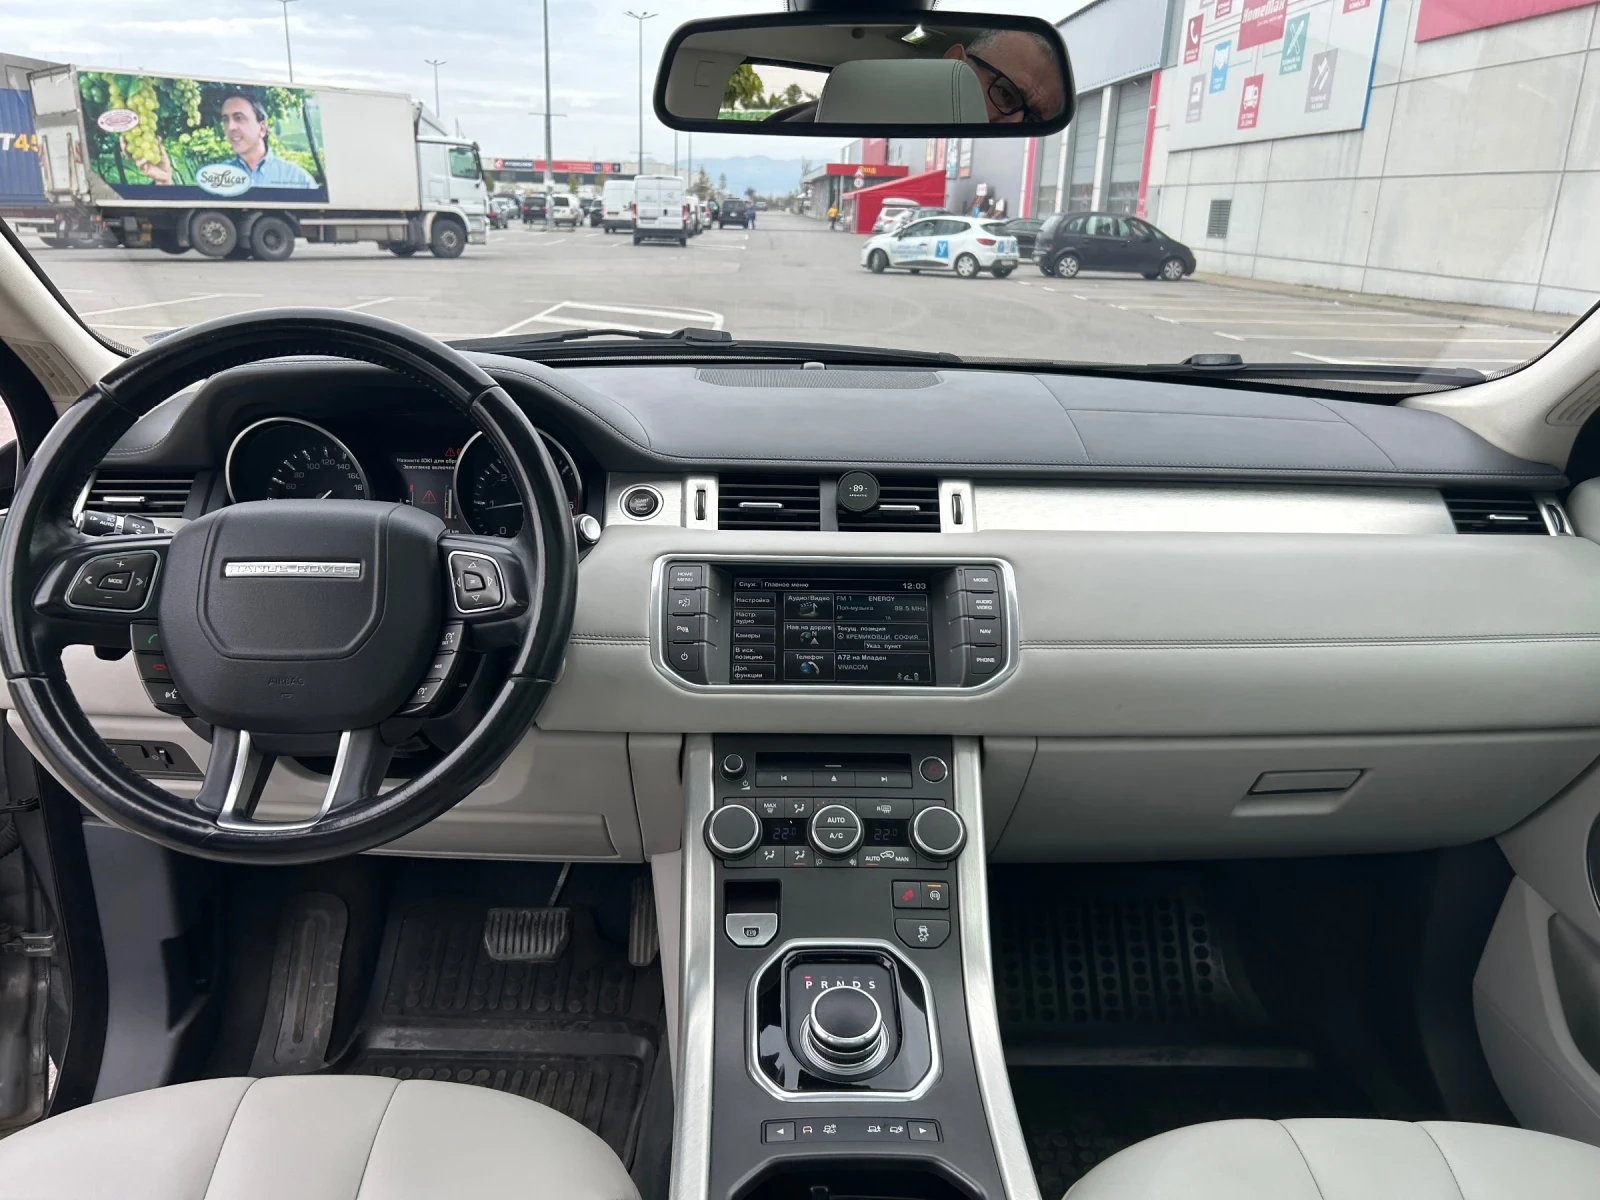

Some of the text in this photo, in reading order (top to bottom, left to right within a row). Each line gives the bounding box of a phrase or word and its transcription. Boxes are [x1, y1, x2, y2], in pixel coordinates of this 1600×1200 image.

[200, 170, 247, 188] SanLucar
[230, 565, 359, 574] RANGE ROVER
[268, 677, 304, 686] AIRBAG
[805, 981, 812, 989] P
[821, 981, 828, 989] R
[869, 981, 876, 989] S
